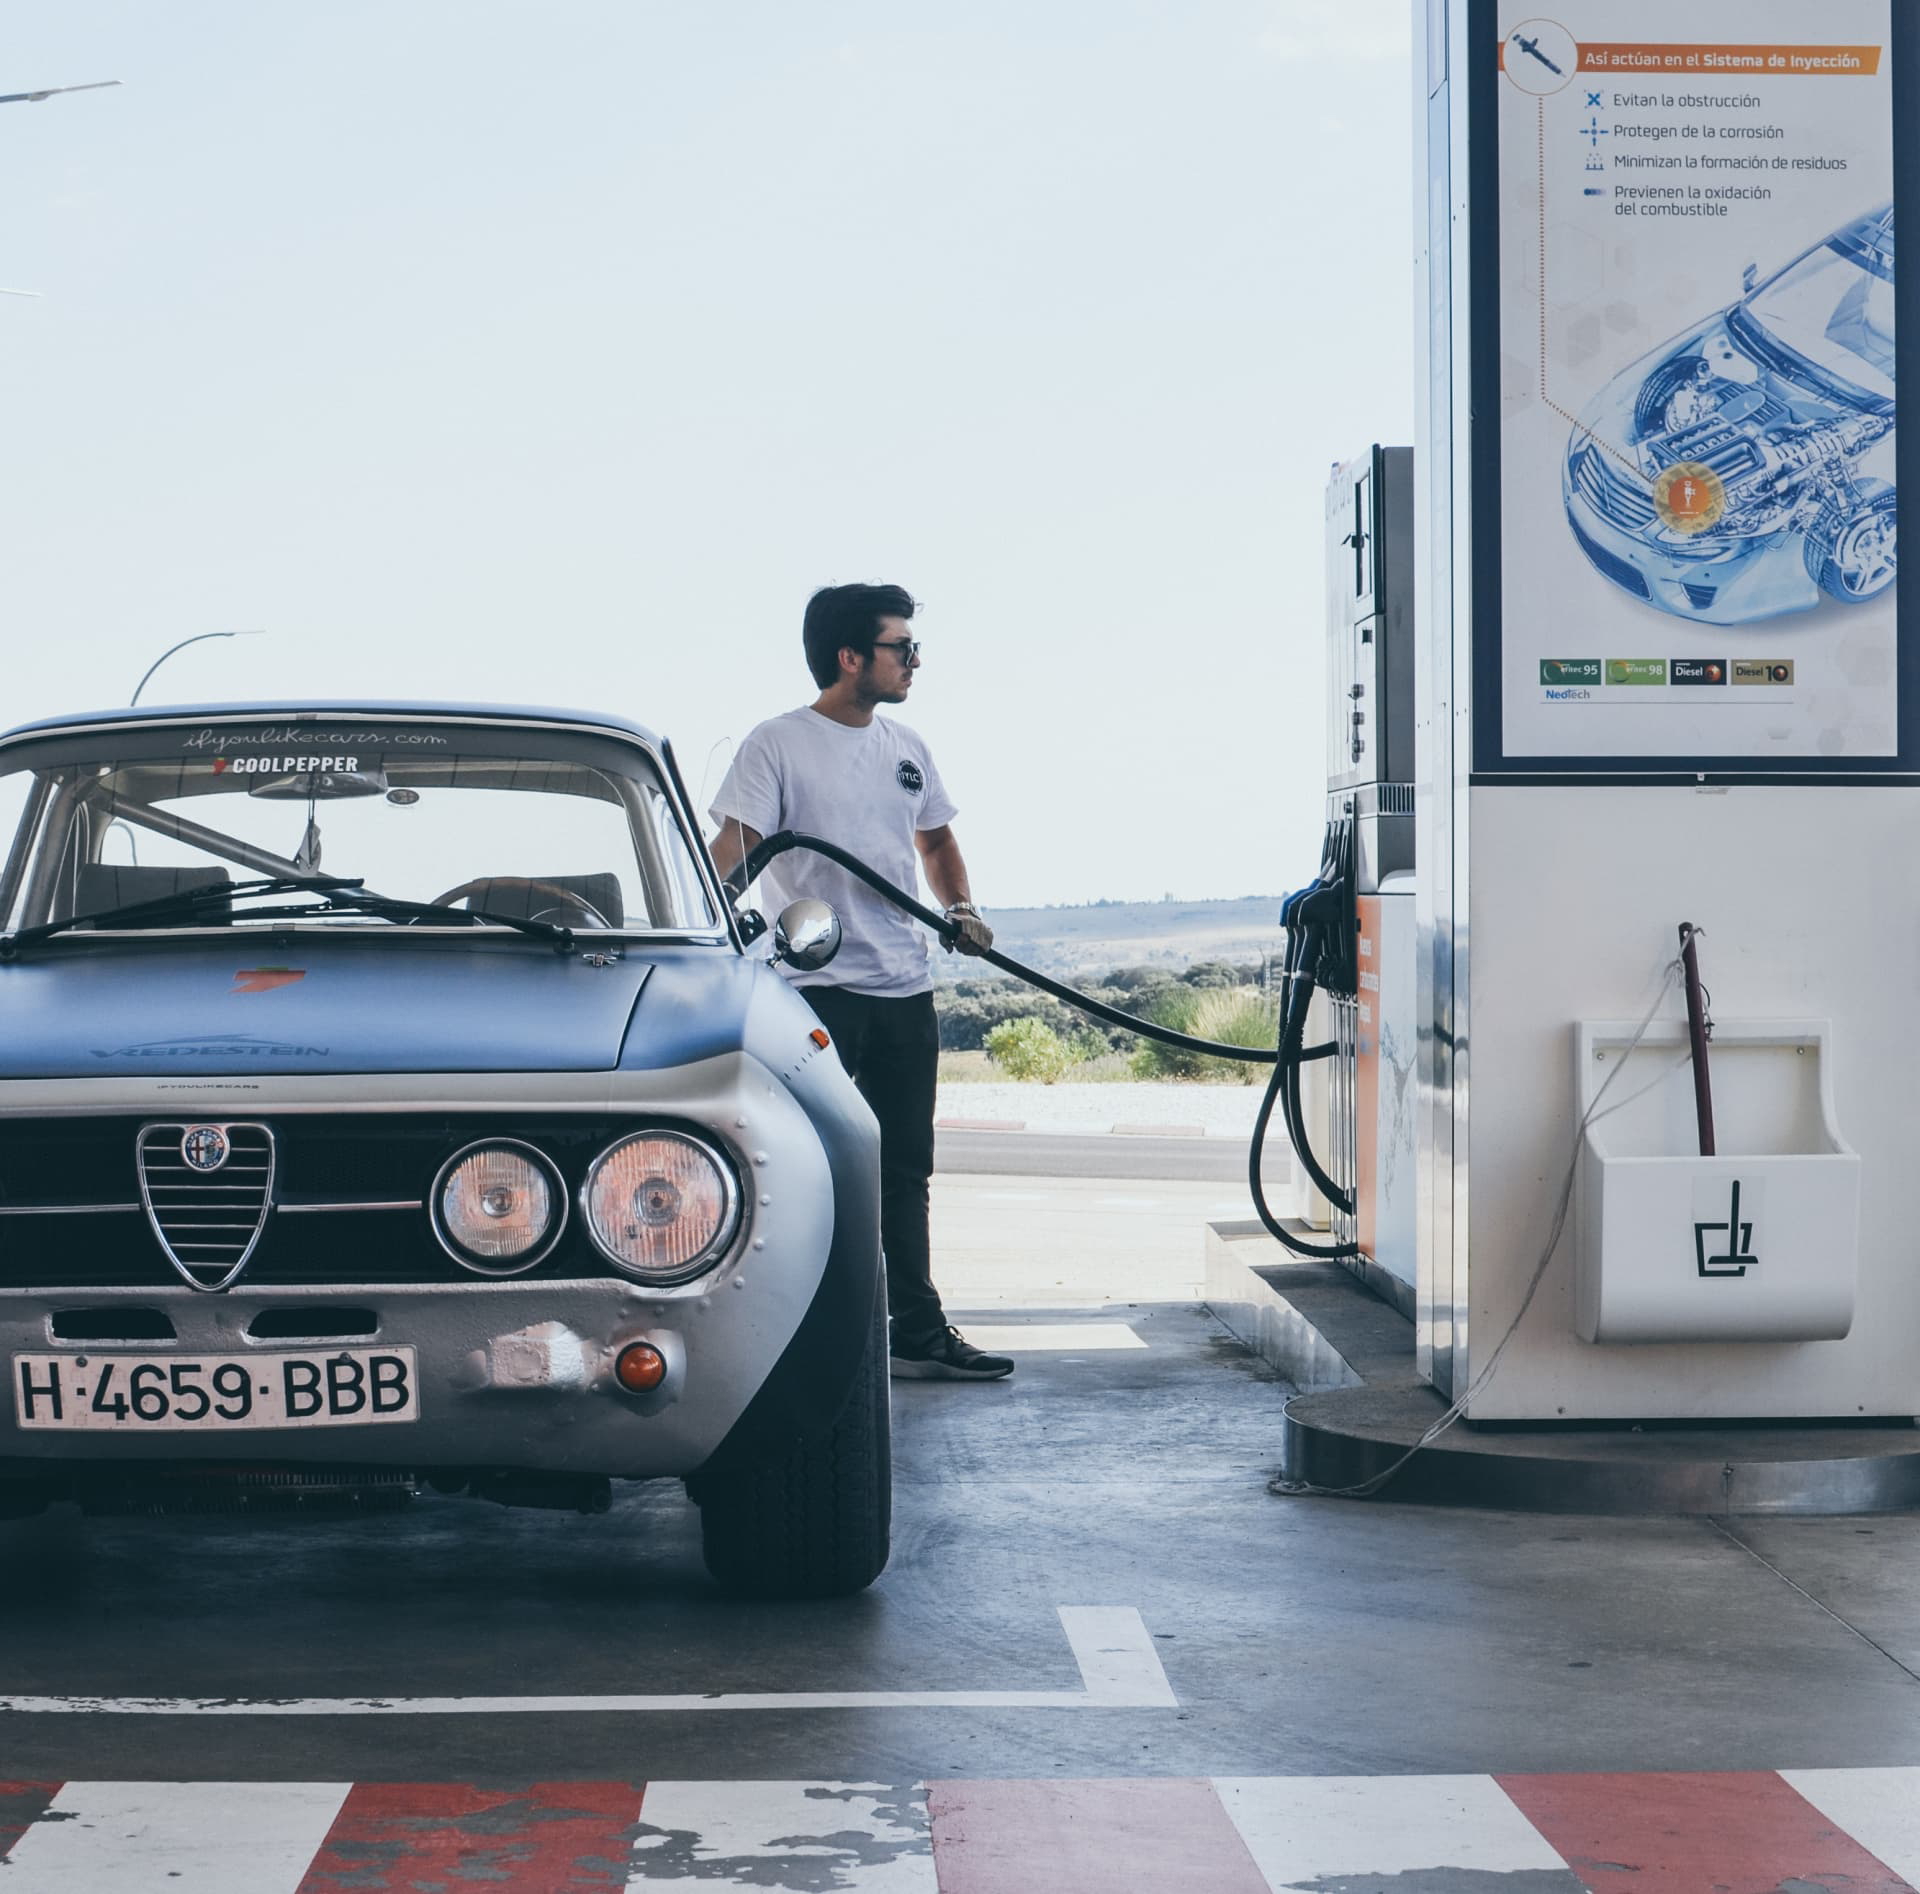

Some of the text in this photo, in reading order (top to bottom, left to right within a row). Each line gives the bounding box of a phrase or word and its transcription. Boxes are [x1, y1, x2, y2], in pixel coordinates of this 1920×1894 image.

[1585, 51, 1860, 70] Así actúan en el Sistema de Inyección
[1613, 93, 1761, 108] Evitan la obstrucción
[1614, 124, 1784, 141] Protegen de la corrosión
[1614, 155, 1847, 170] Minimizan la formación de residuos
[1614, 185, 1771, 200] Previenen la oxidación
[1614, 202, 1728, 217] del combustible
[1583, 664, 1598, 675] 95
[1648, 664, 1663, 675] 98
[1675, 666, 1703, 676] Diesel
[1736, 665, 1788, 682] Diesel 10
[231, 756, 358, 774] COOLPEPPER
[88, 1046, 330, 1058] VREDESTEIN
